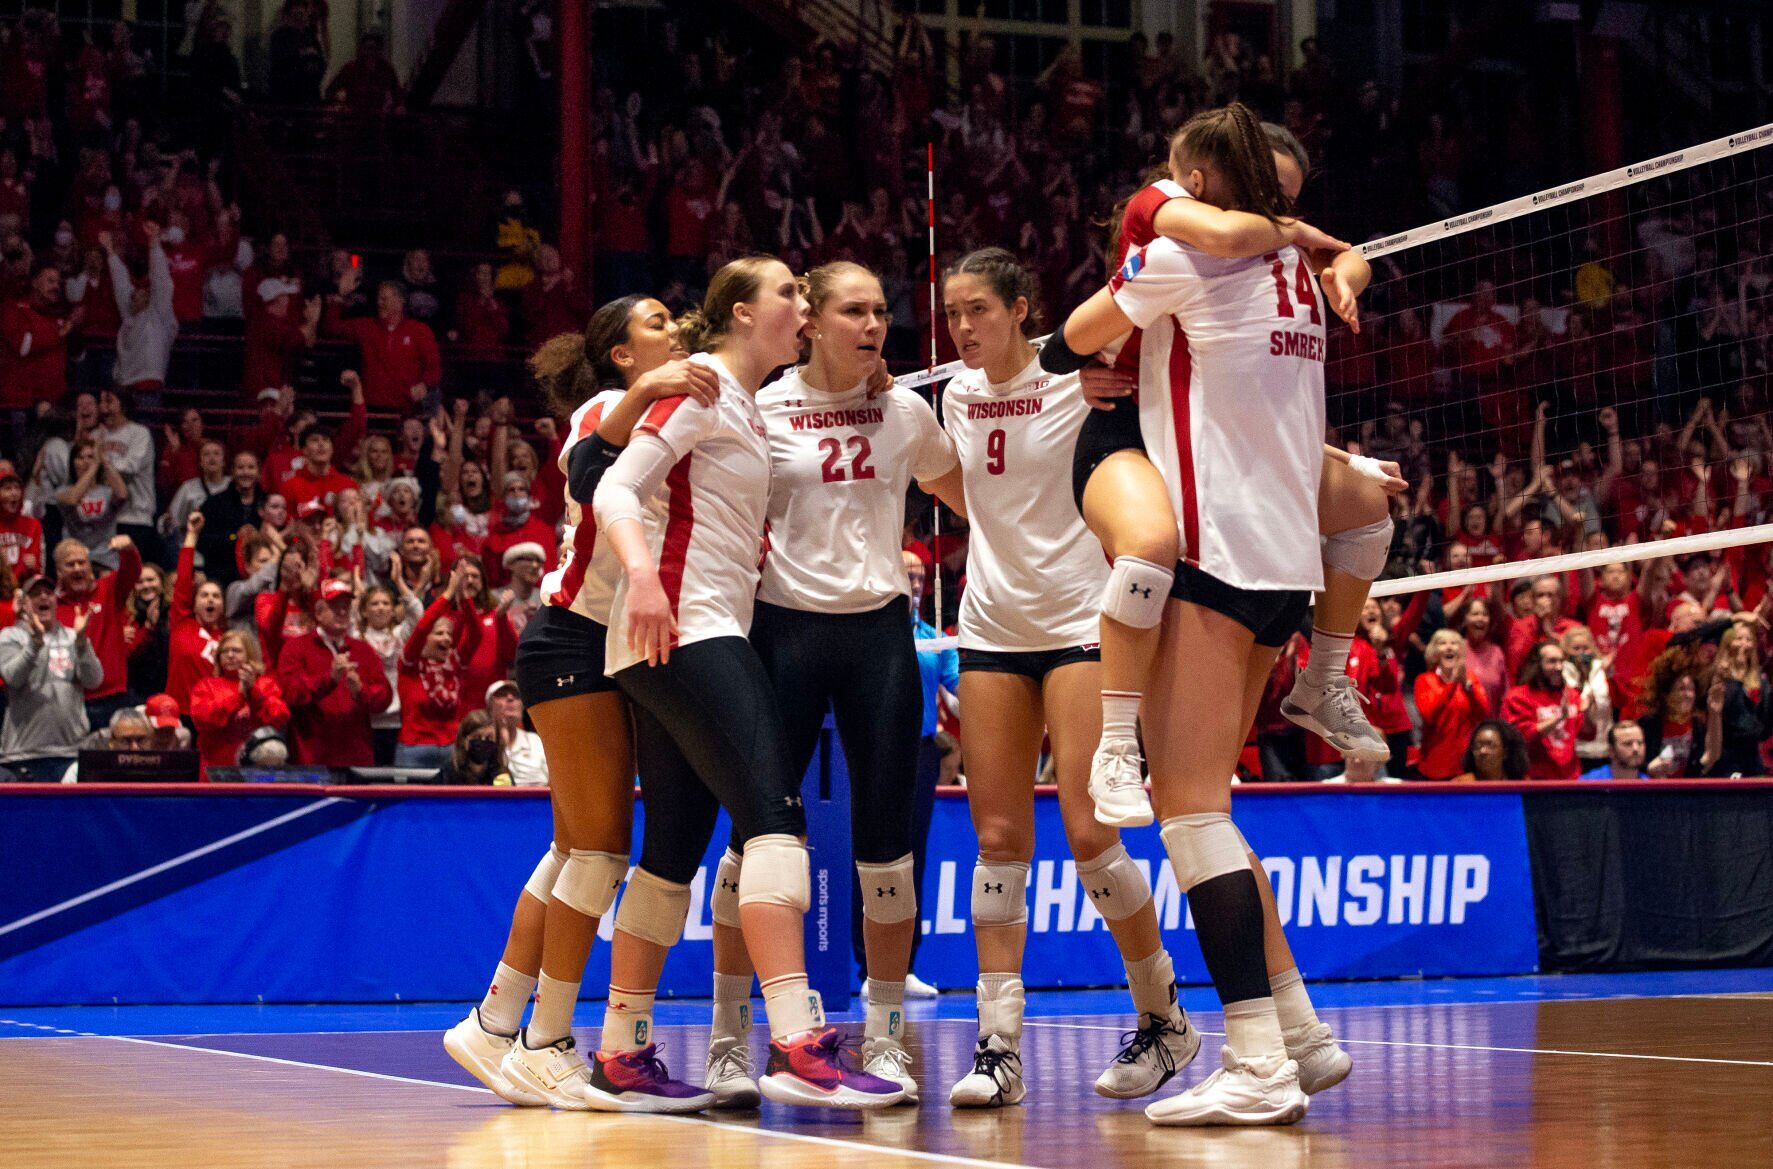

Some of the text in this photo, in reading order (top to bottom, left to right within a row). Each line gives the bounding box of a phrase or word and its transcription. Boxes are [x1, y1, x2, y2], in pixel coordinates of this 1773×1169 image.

[1735, 134, 1758, 146] VOLLEYBALL
[1633, 154, 1684, 175] VOLLEYBALL CHAMPIONSHIP
[1538, 183, 1585, 203] VOLLEYBALL CHAMPIONSHIP
[1449, 210, 1493, 229] VOLLEYBALL CHAMPIONSHIP
[1367, 235, 1408, 252] VOLLEYBALL CHAMPIONSHIP
[1263, 252, 1322, 326] 14
[789, 407, 884, 431] WISCONSIN
[967, 398, 1043, 420] WISCONSIN
[818, 435, 875, 483] 22
[986, 428, 1006, 476] 9
[816, 869, 829, 952] sports imports
